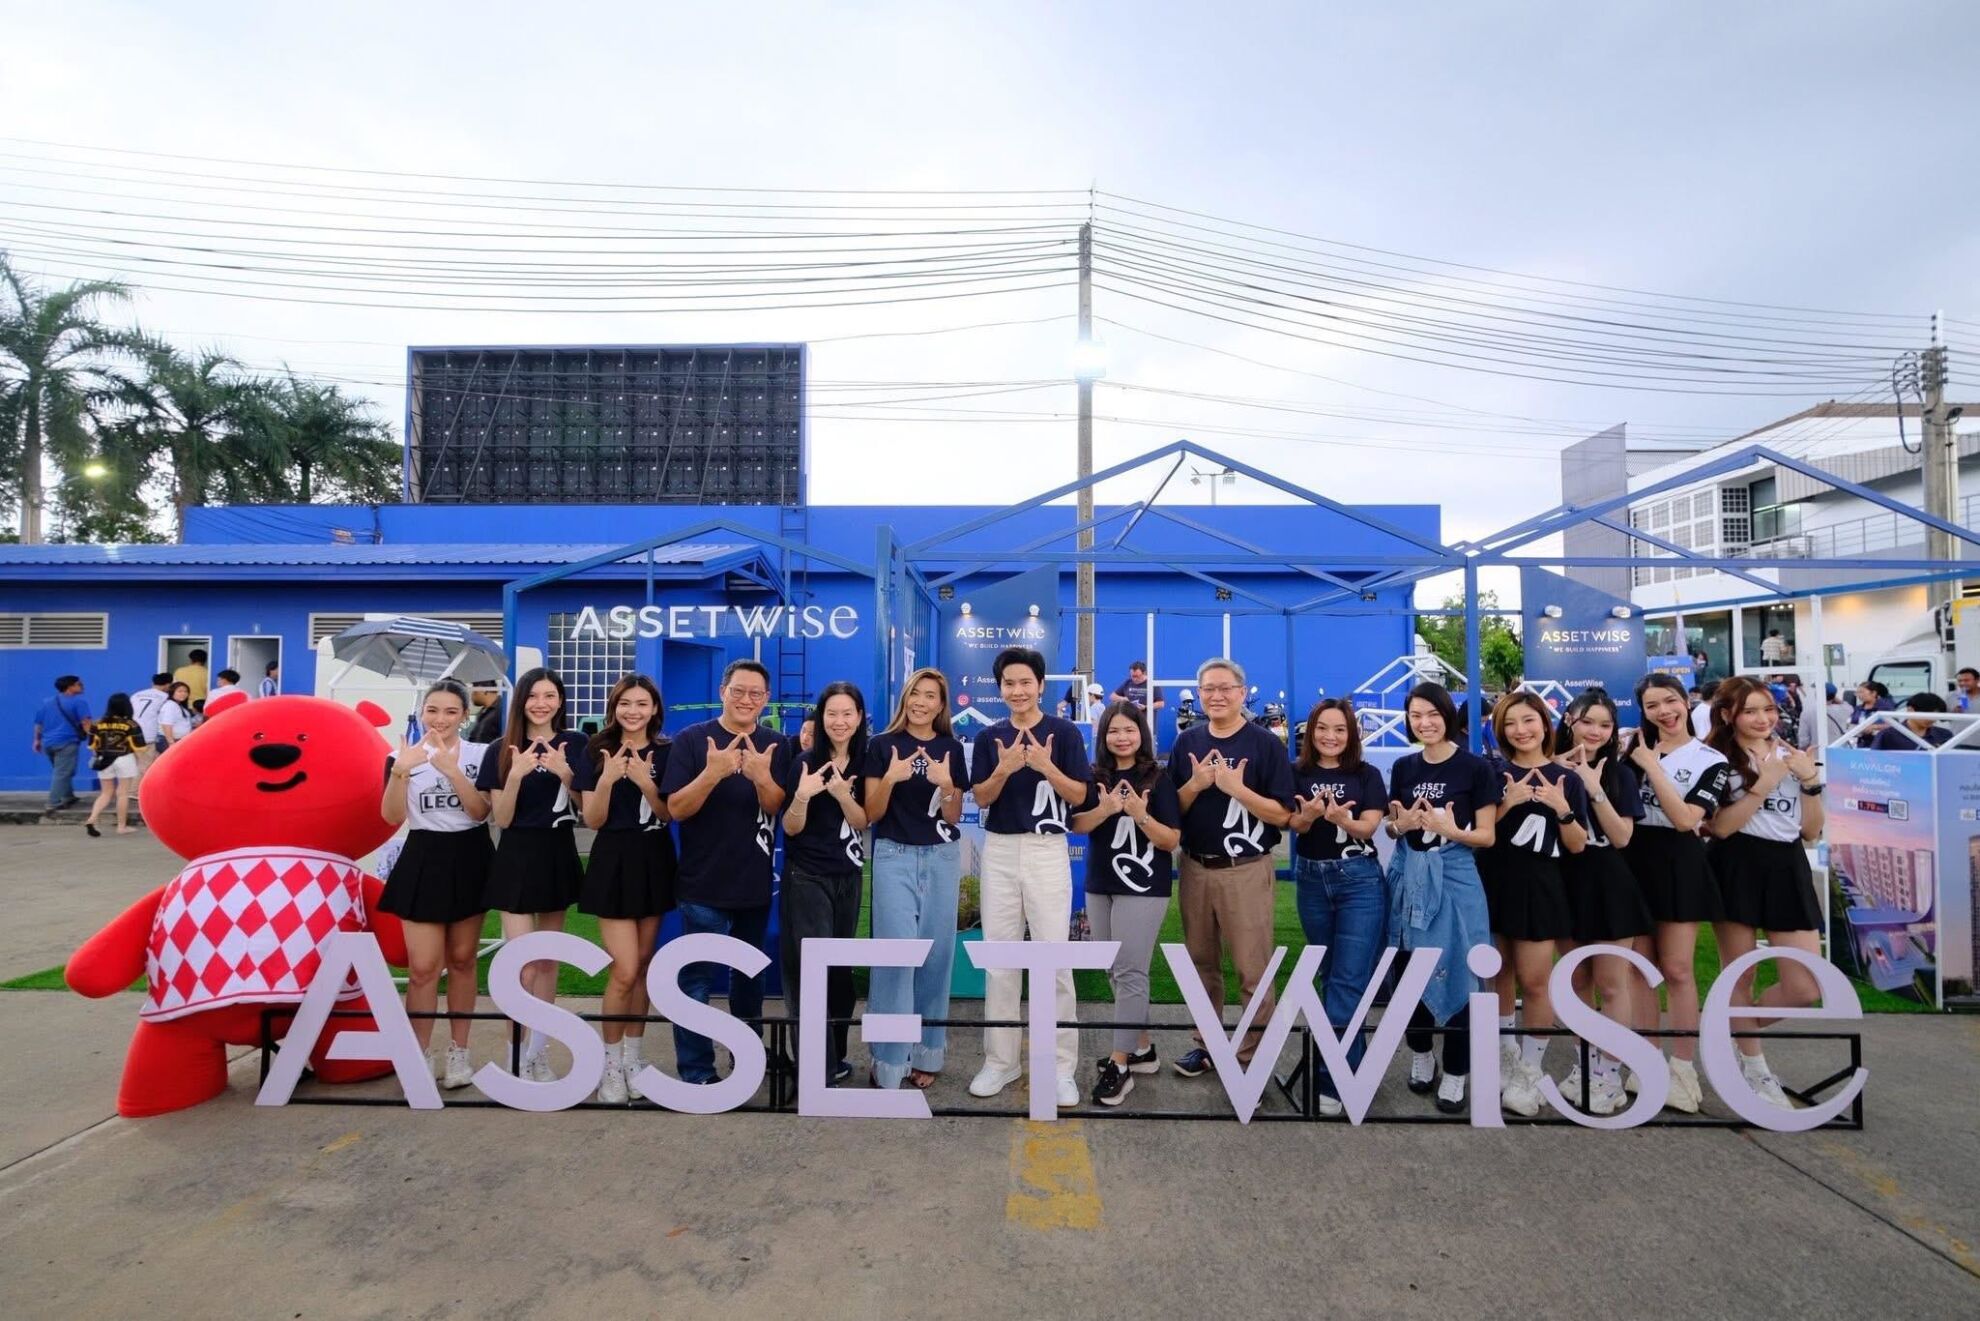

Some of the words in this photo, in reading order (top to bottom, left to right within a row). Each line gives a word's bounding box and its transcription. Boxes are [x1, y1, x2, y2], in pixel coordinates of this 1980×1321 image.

[139, 699, 152, 719] 7
[1414, 782, 1446, 791] ASSET
[424, 794, 462, 809] LEO
